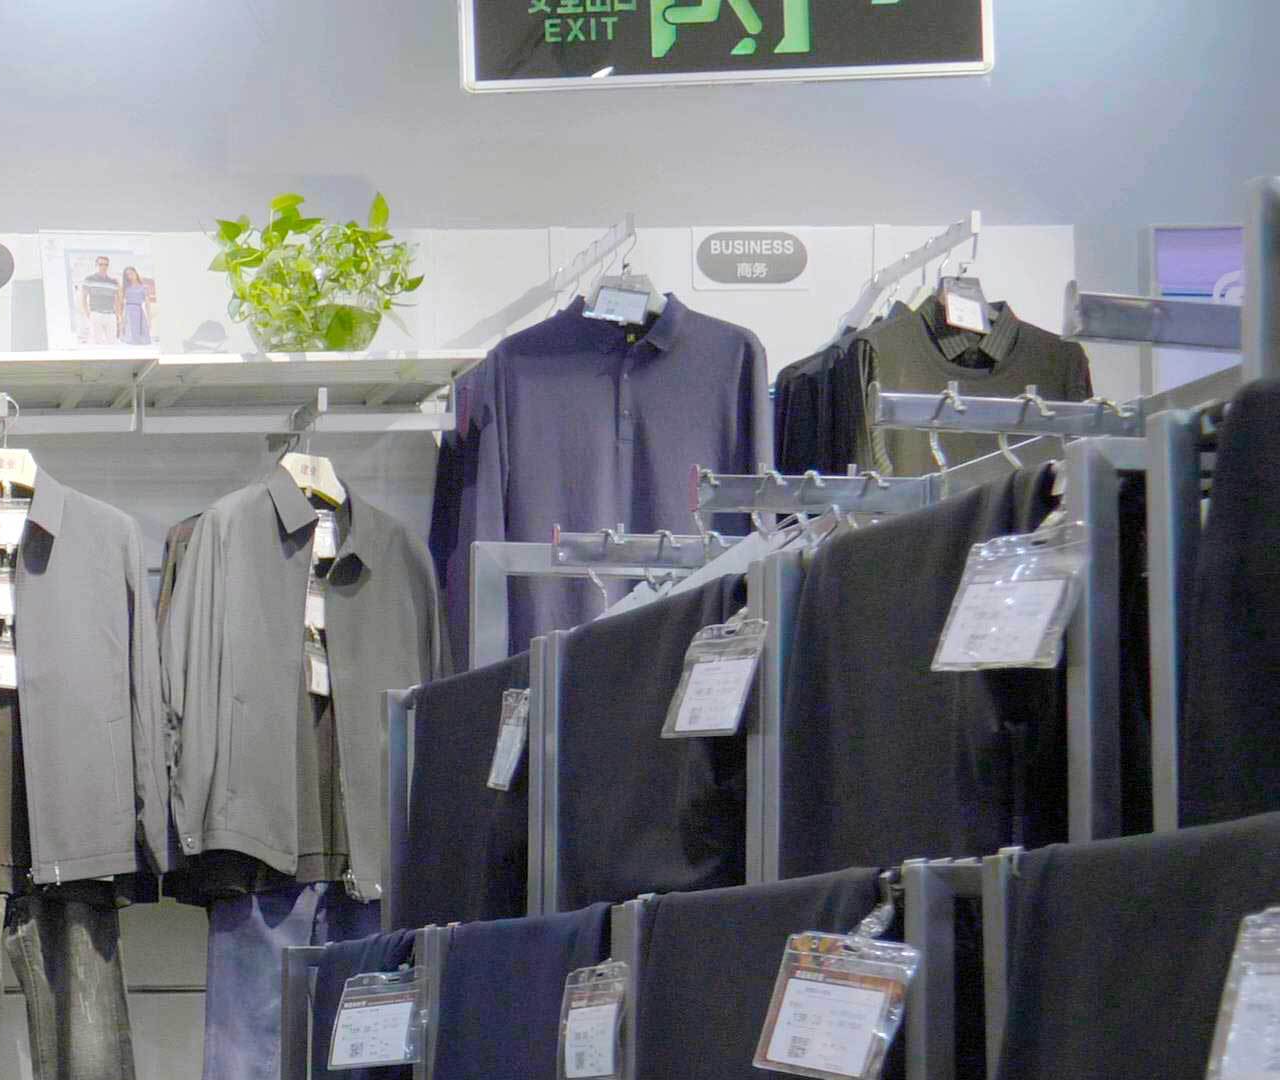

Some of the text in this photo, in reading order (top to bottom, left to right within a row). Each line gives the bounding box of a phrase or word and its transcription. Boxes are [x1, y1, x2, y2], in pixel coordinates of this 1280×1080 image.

[544, 16, 619, 43] EXIT
[710, 239, 795, 255] BUSINESS
[736, 262, 768, 278] 商务
